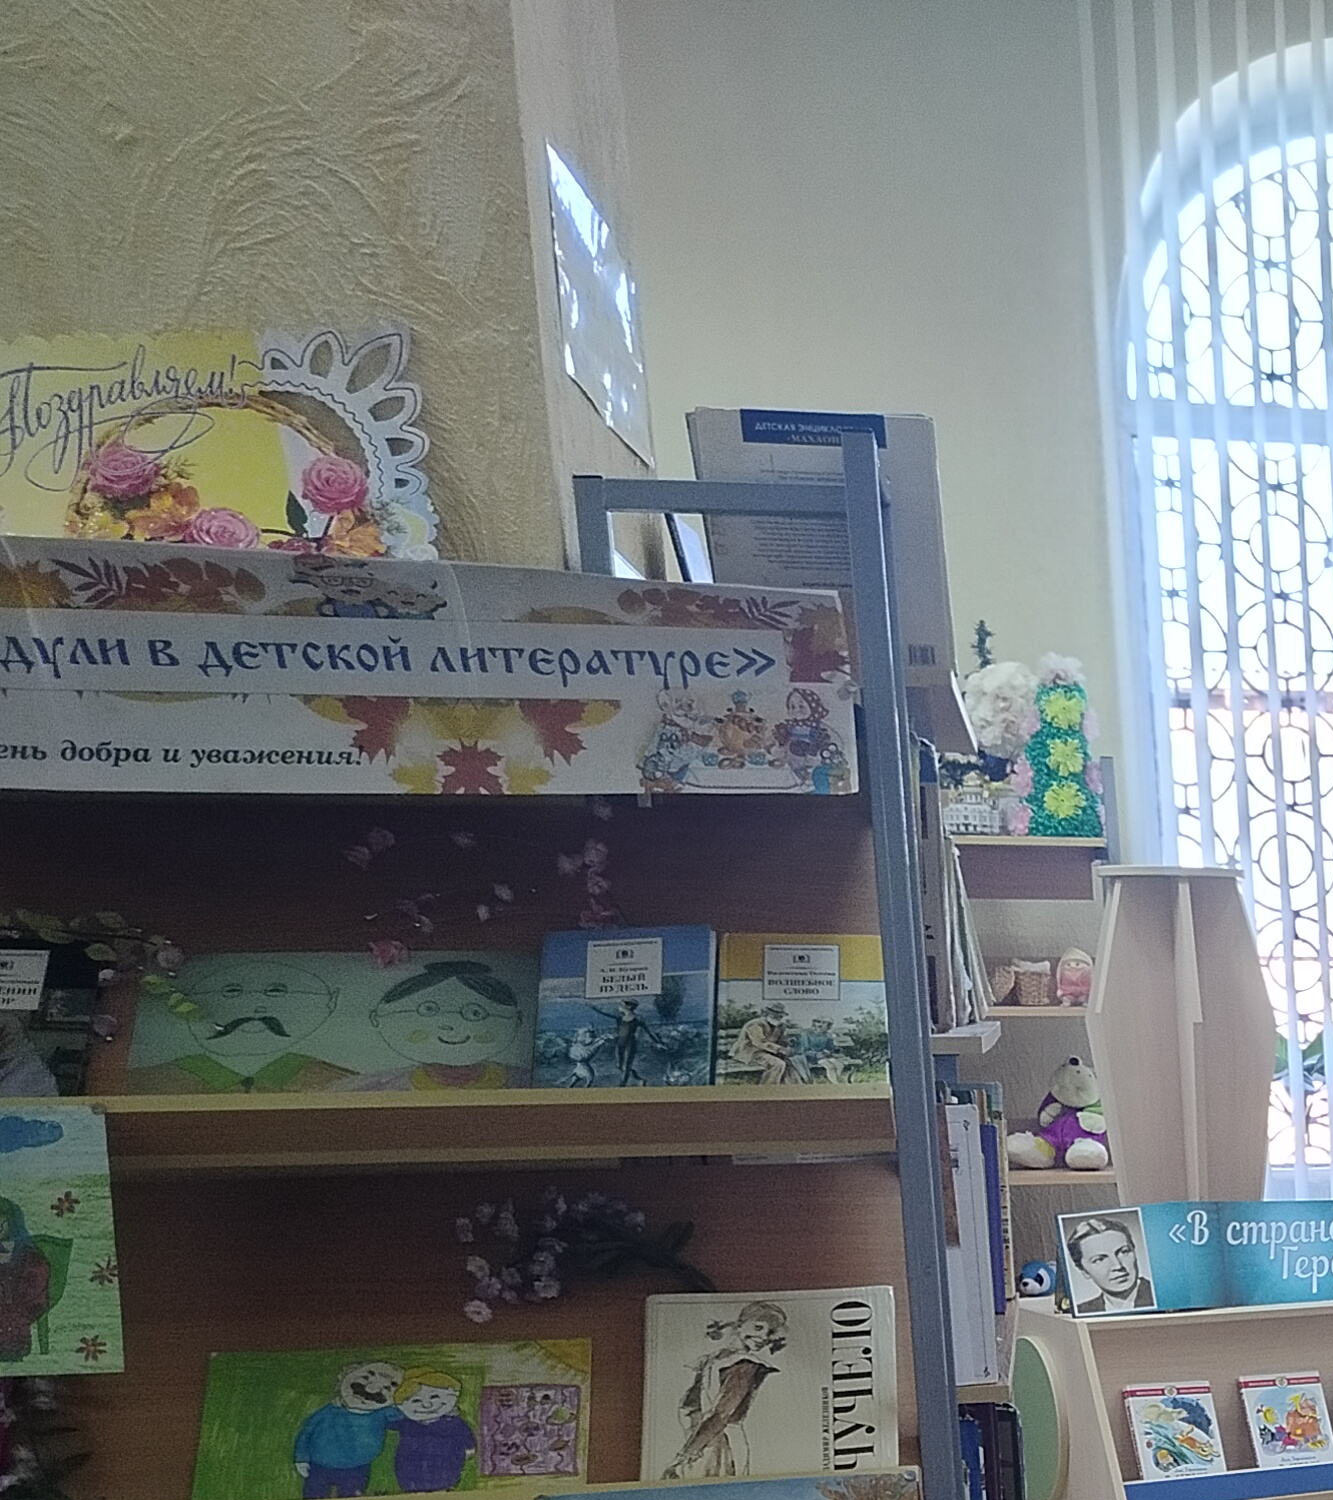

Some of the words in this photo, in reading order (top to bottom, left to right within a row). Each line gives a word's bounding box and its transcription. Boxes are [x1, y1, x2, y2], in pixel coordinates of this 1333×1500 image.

[198, 634, 412, 678] ДЕТСКОЙ
[60, 740, 151, 768] добра
[163, 748, 181, 763] и
[190, 746, 364, 769] уважения!
[830, 1300, 876, 1471] ЧУЧЕЛО
